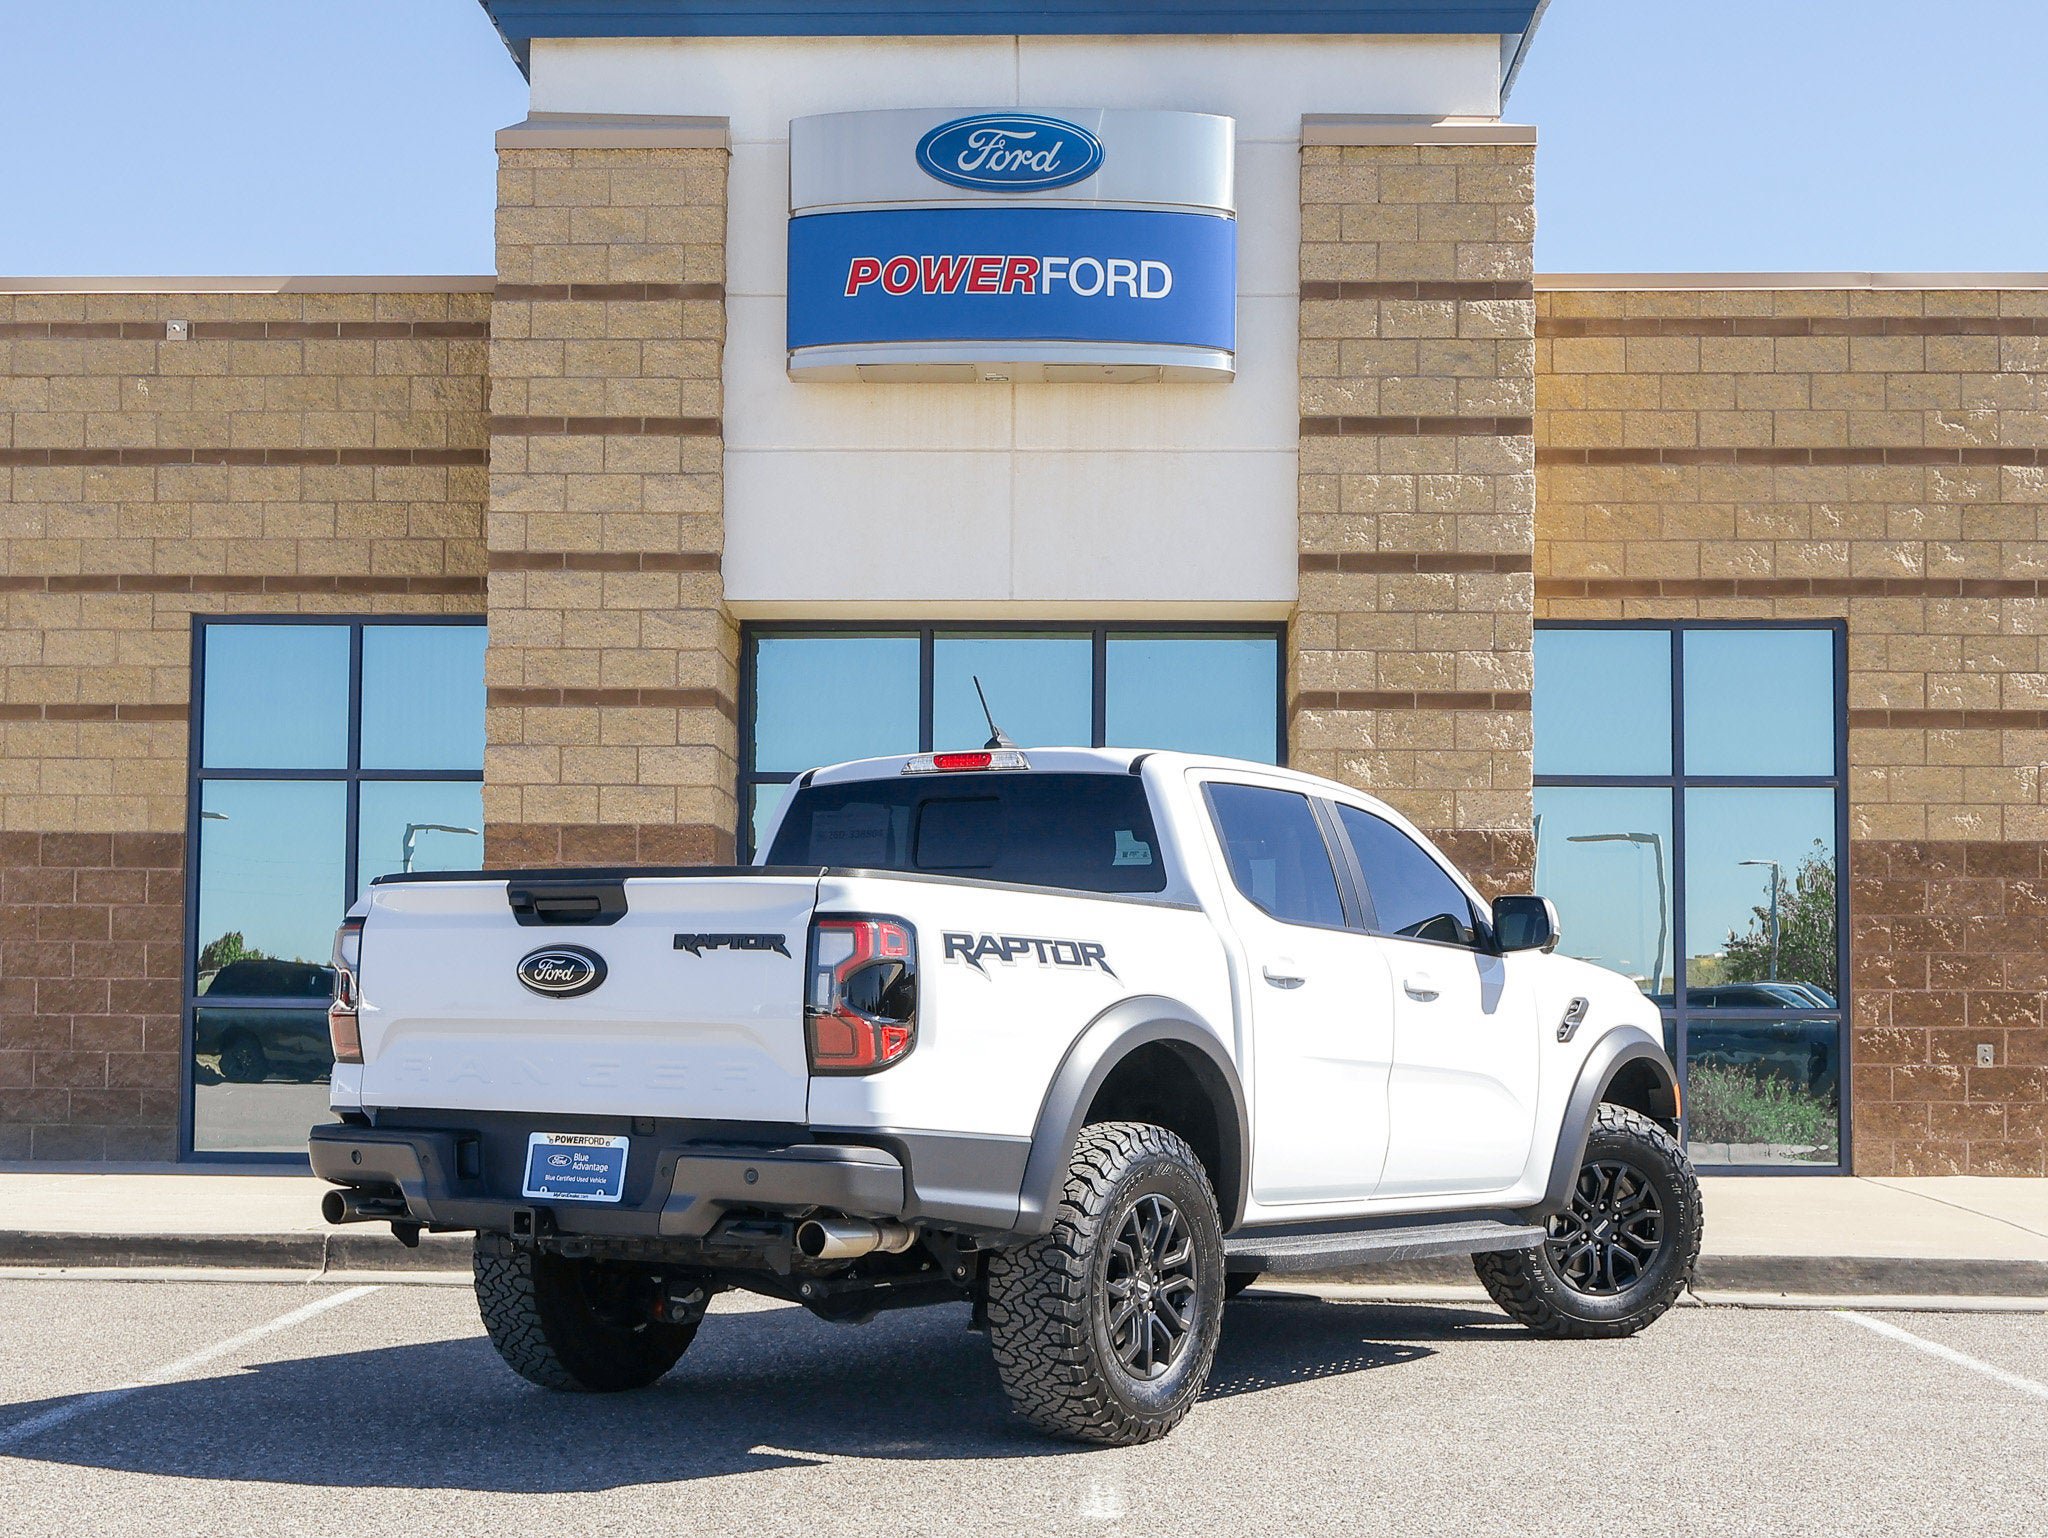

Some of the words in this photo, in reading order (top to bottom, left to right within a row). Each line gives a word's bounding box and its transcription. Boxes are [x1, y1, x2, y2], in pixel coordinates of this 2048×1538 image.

[957, 128, 1063, 173] Ford
[844, 255, 1173, 299] POWERFORD
[673, 932, 792, 959] RAPTOR
[942, 931, 1122, 984] RAPTOR
[534, 958, 575, 981] Ford
[554, 1135, 605, 1146] POWERFORD
[571, 1162, 609, 1172] Advantage
[573, 1152, 590, 1162] Blue
[589, 1176, 607, 1184] Vehicle
